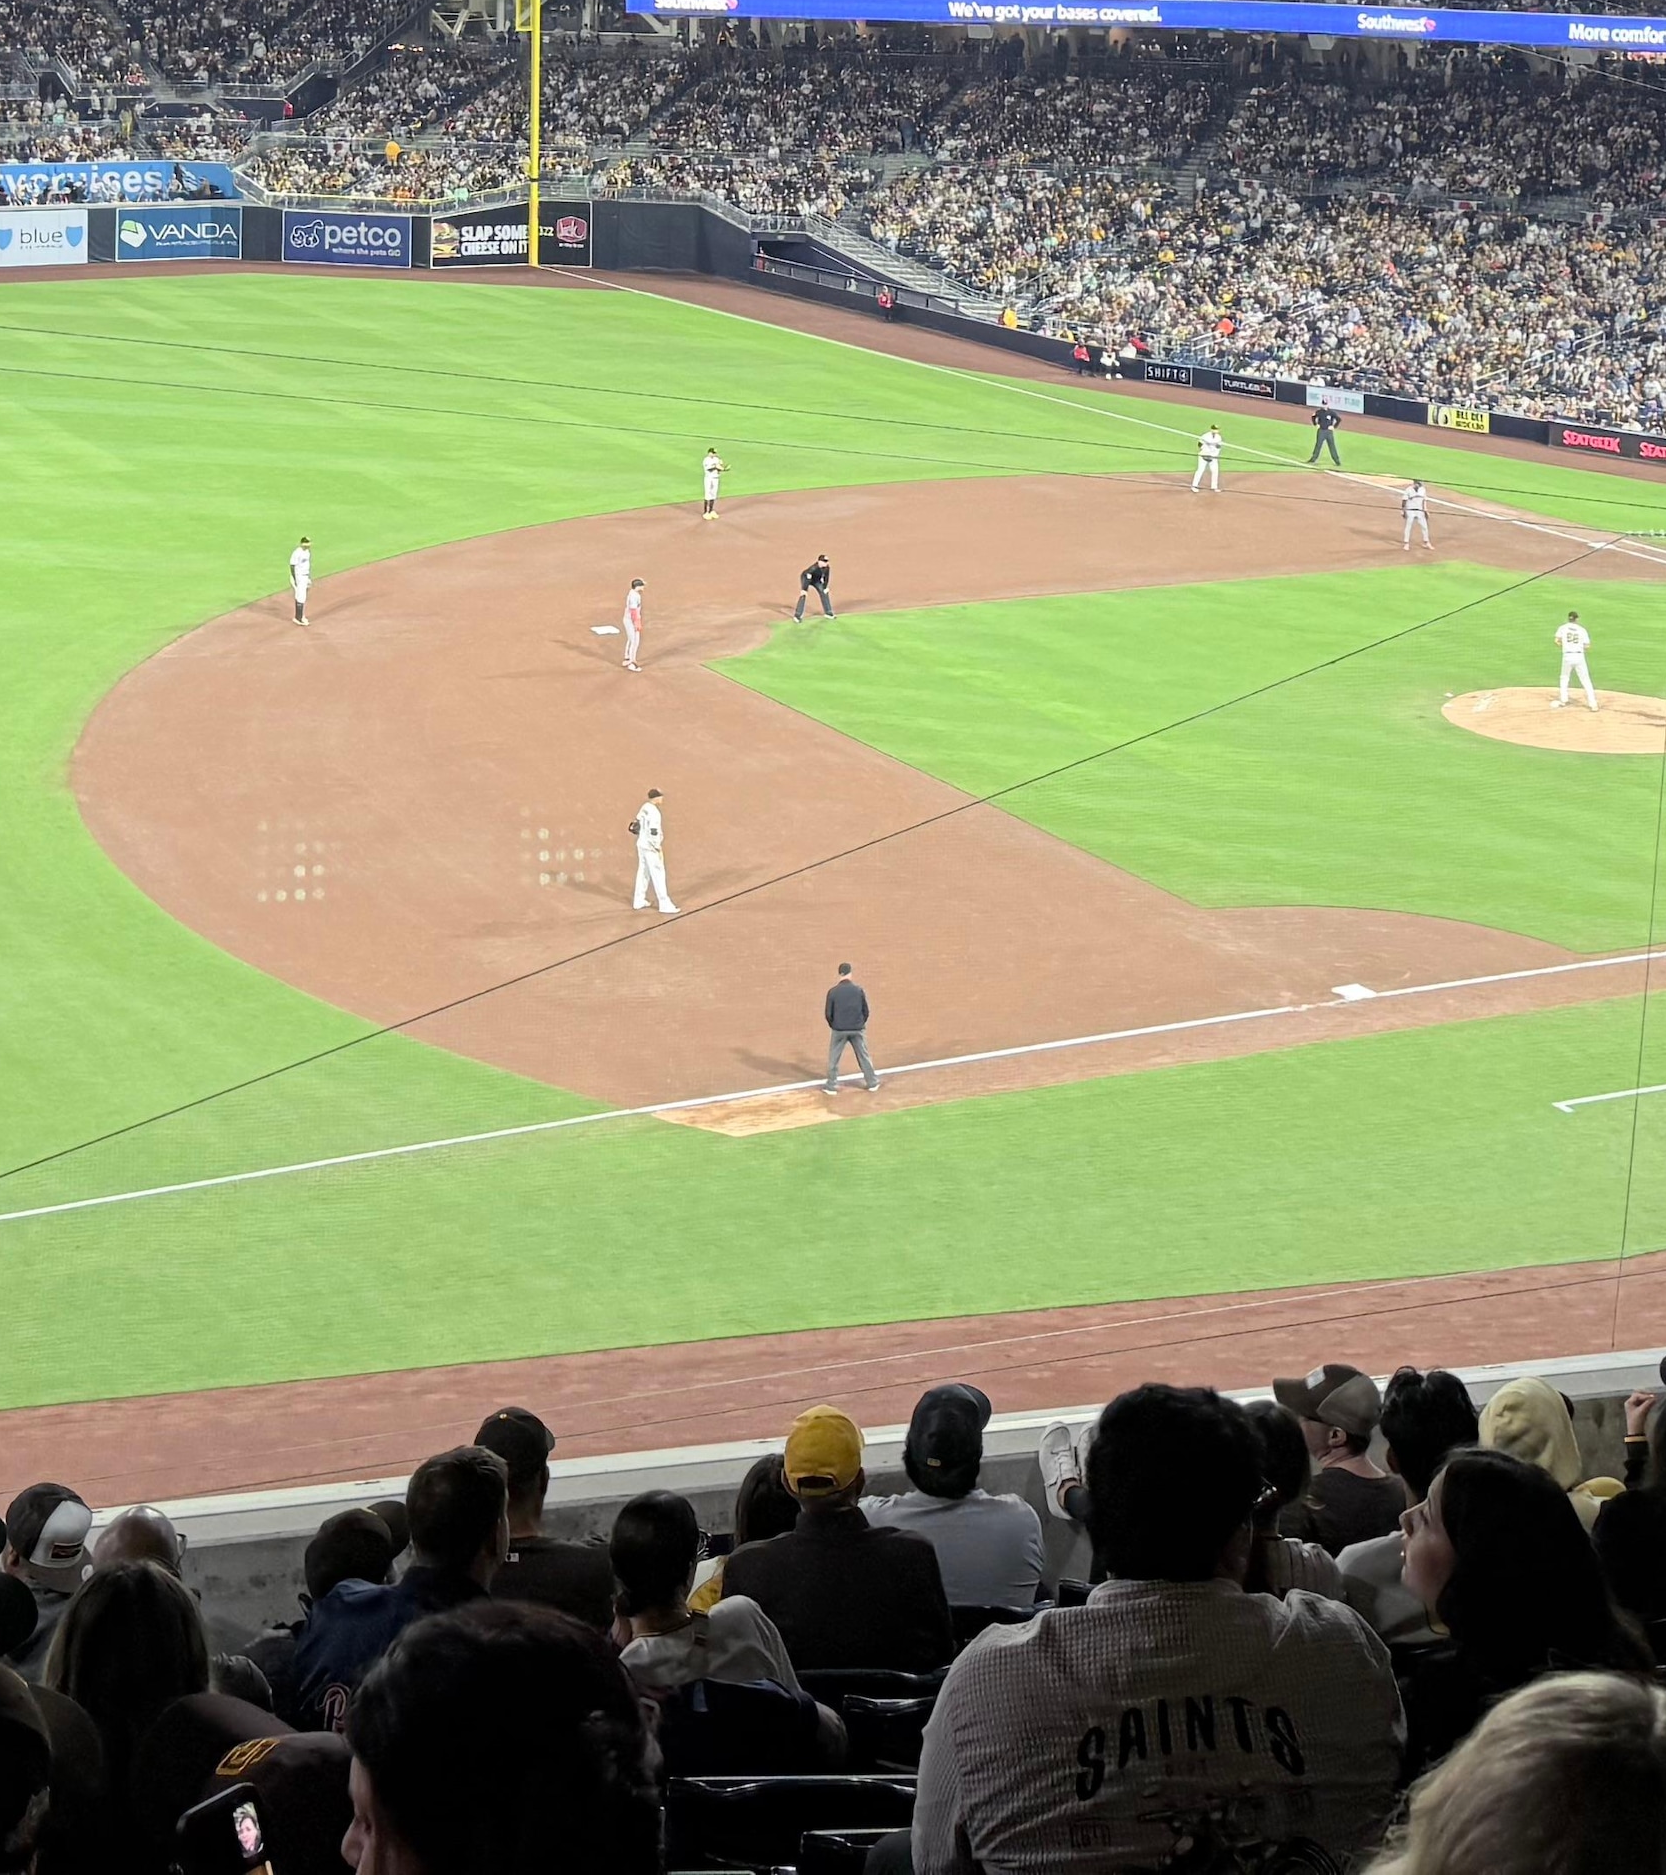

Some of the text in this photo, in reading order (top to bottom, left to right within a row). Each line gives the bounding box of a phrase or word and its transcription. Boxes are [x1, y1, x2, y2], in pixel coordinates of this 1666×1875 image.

[948, 1, 993, 19] We've
[995, 5, 1020, 23] got
[1022, 7, 1054, 24] your
[1057, 3, 1097, 21] bases
[1100, 5, 1161, 23] covered.
[1357, 14, 1426, 33] Southwest
[1569, 23, 1607, 42] More
[20, 227, 63, 245] blue
[149, 223, 237, 239] VANDA
[325, 223, 401, 249] petco
[461, 225, 527, 241] SLAP SOME
[461, 241, 499, 256] CHEESE
[500, 240, 517, 255] ON
[1562, 430, 1621, 453] SEATGEEK
[1076, 1695, 1305, 1801] SAINTS
